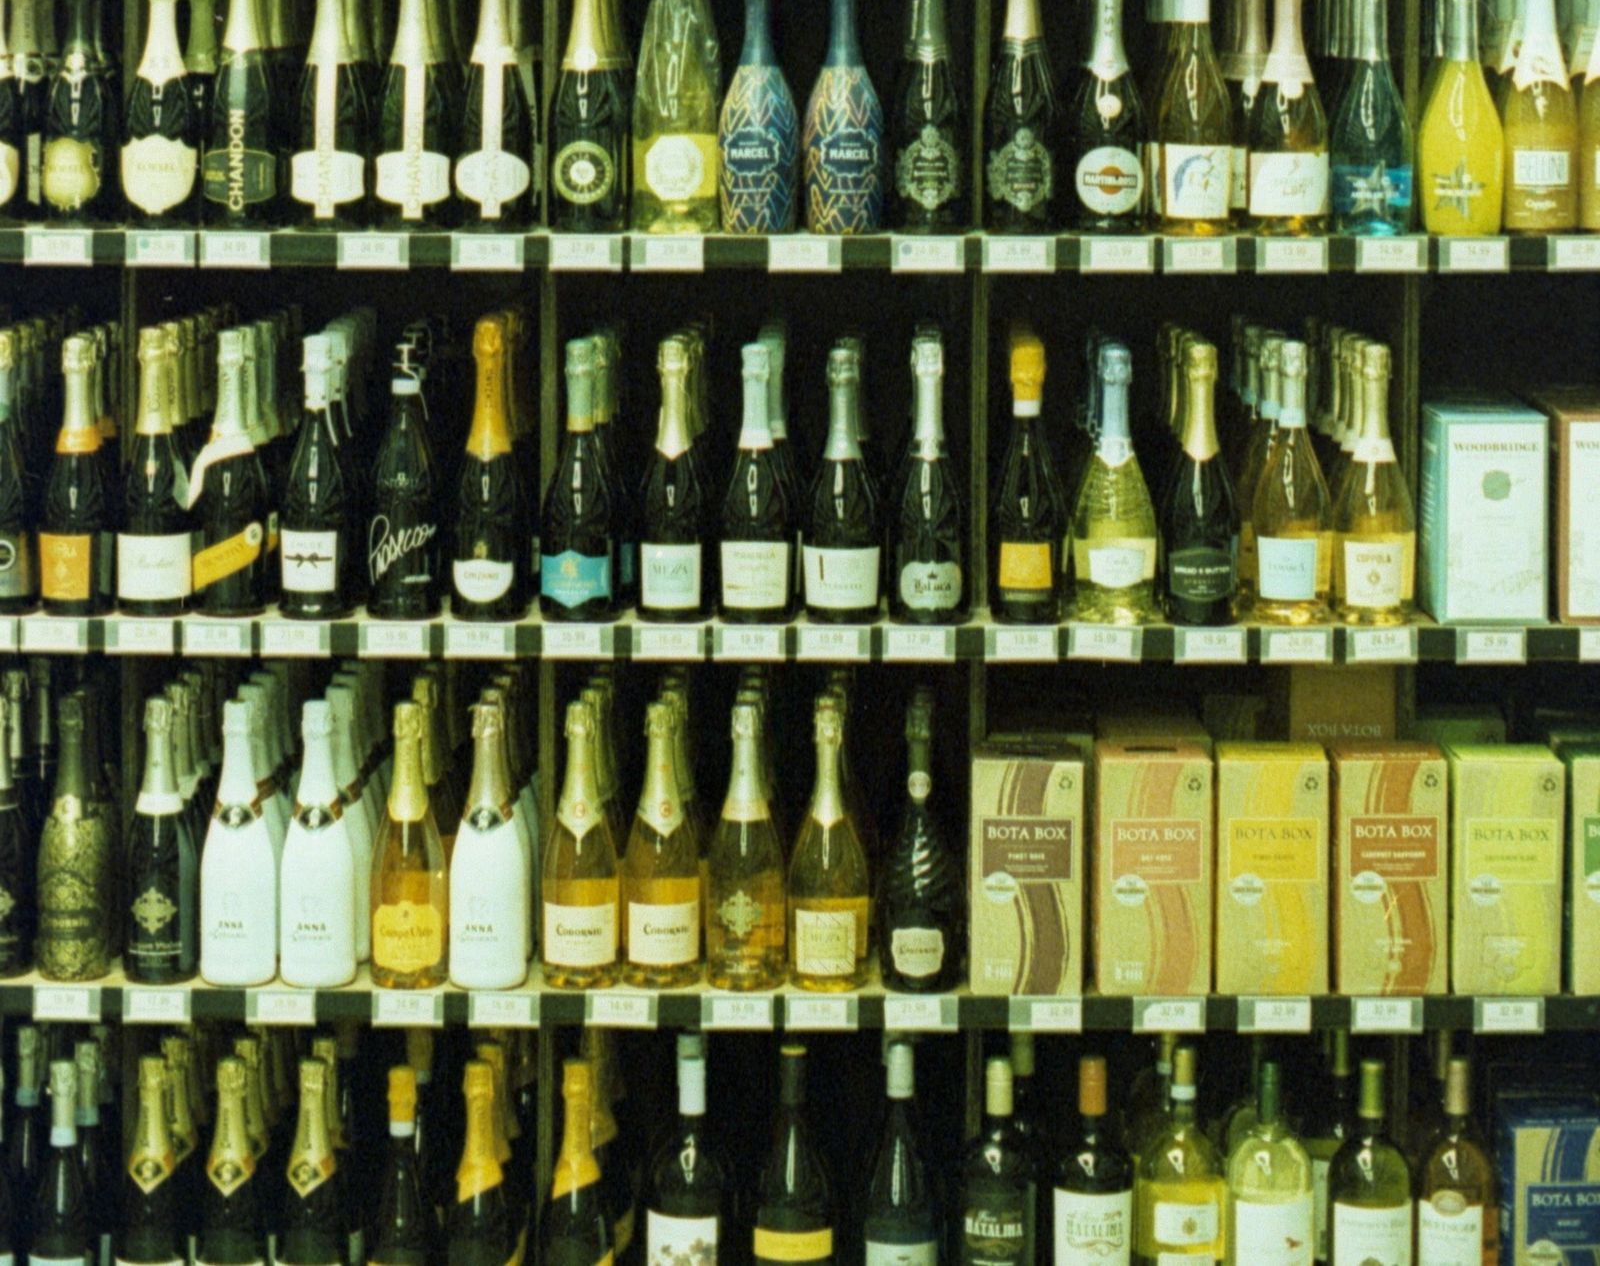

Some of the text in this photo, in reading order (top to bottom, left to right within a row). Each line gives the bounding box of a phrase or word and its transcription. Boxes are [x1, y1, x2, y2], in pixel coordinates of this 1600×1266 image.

[229, 108, 246, 212] CHANDON
[730, 147, 771, 160] MARCEL
[829, 147, 871, 160] MARCEL
[1453, 440, 1539, 453] WOODBRIDGE
[1356, 553, 1392, 564] COPPOLA
[987, 826, 1067, 840] BOTA BOX
[1117, 828, 1197, 841] BOTA BOX
[1235, 827, 1313, 841] BOTA BOX
[1355, 825, 1432, 839] BOTA BOX
[1474, 828, 1550, 842] BOTA BOX
[219, 921, 244, 930] ANNA
[297, 923, 327, 932] ANNA
[464, 923, 494, 933] ANNA
[1531, 1193, 1573, 1207] BOTA
